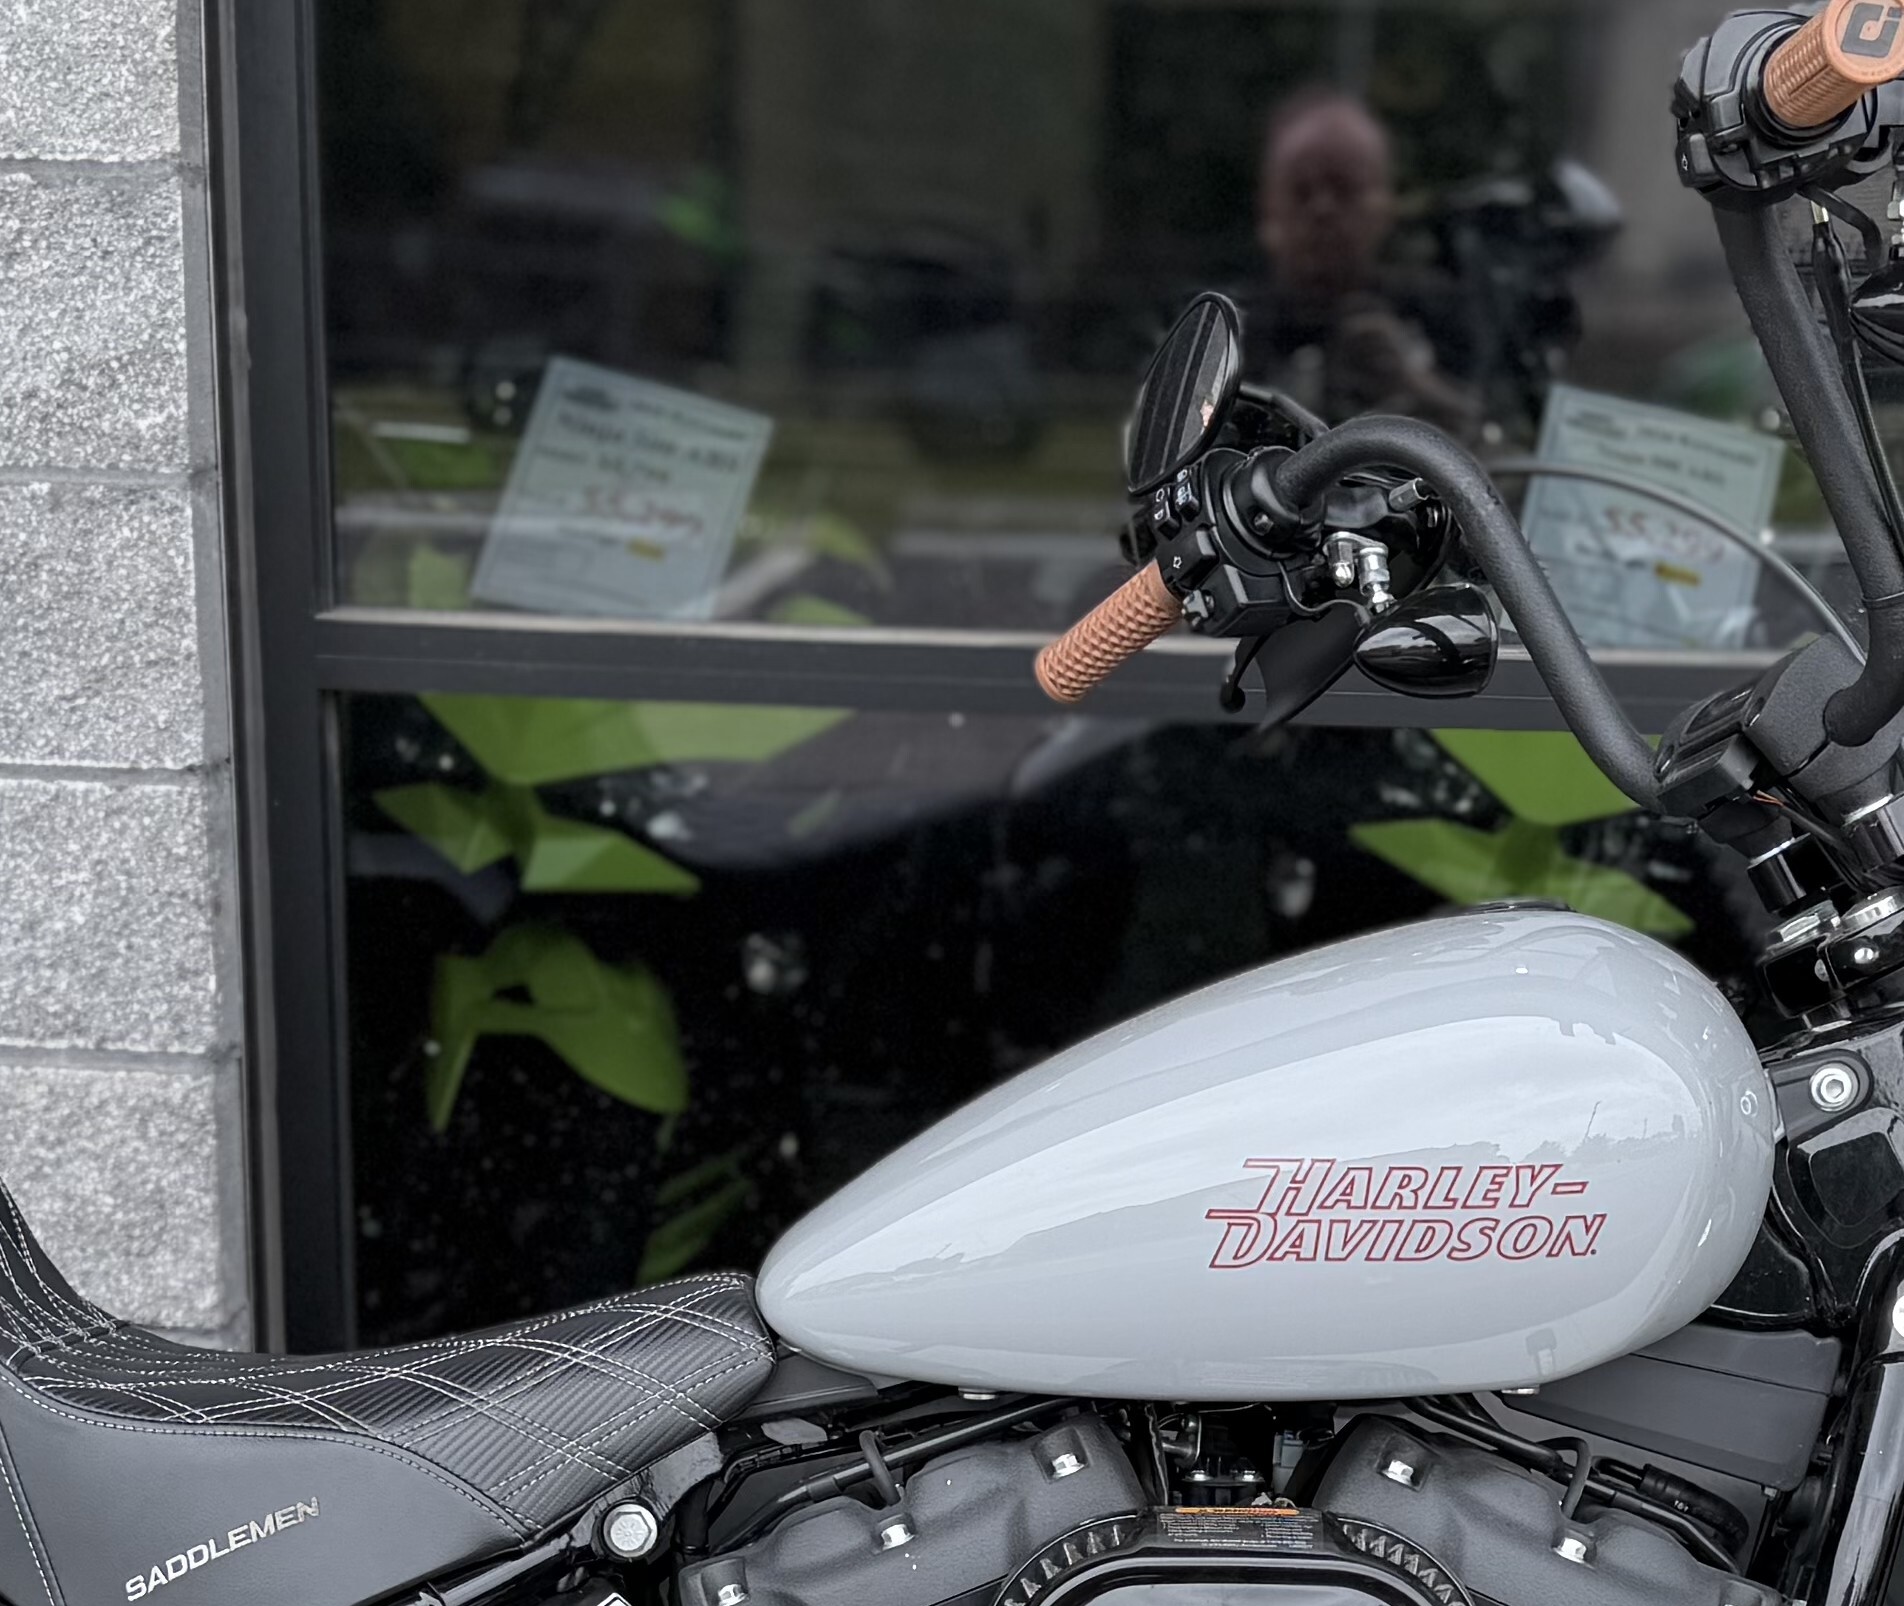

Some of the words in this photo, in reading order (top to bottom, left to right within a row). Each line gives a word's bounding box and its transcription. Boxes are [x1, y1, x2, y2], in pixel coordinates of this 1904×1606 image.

[1243, 1157, 1590, 1217] HARLEY-
[1205, 1207, 1607, 1269] DAVIDSON
[125, 1496, 320, 1602] SADDLEMEN
